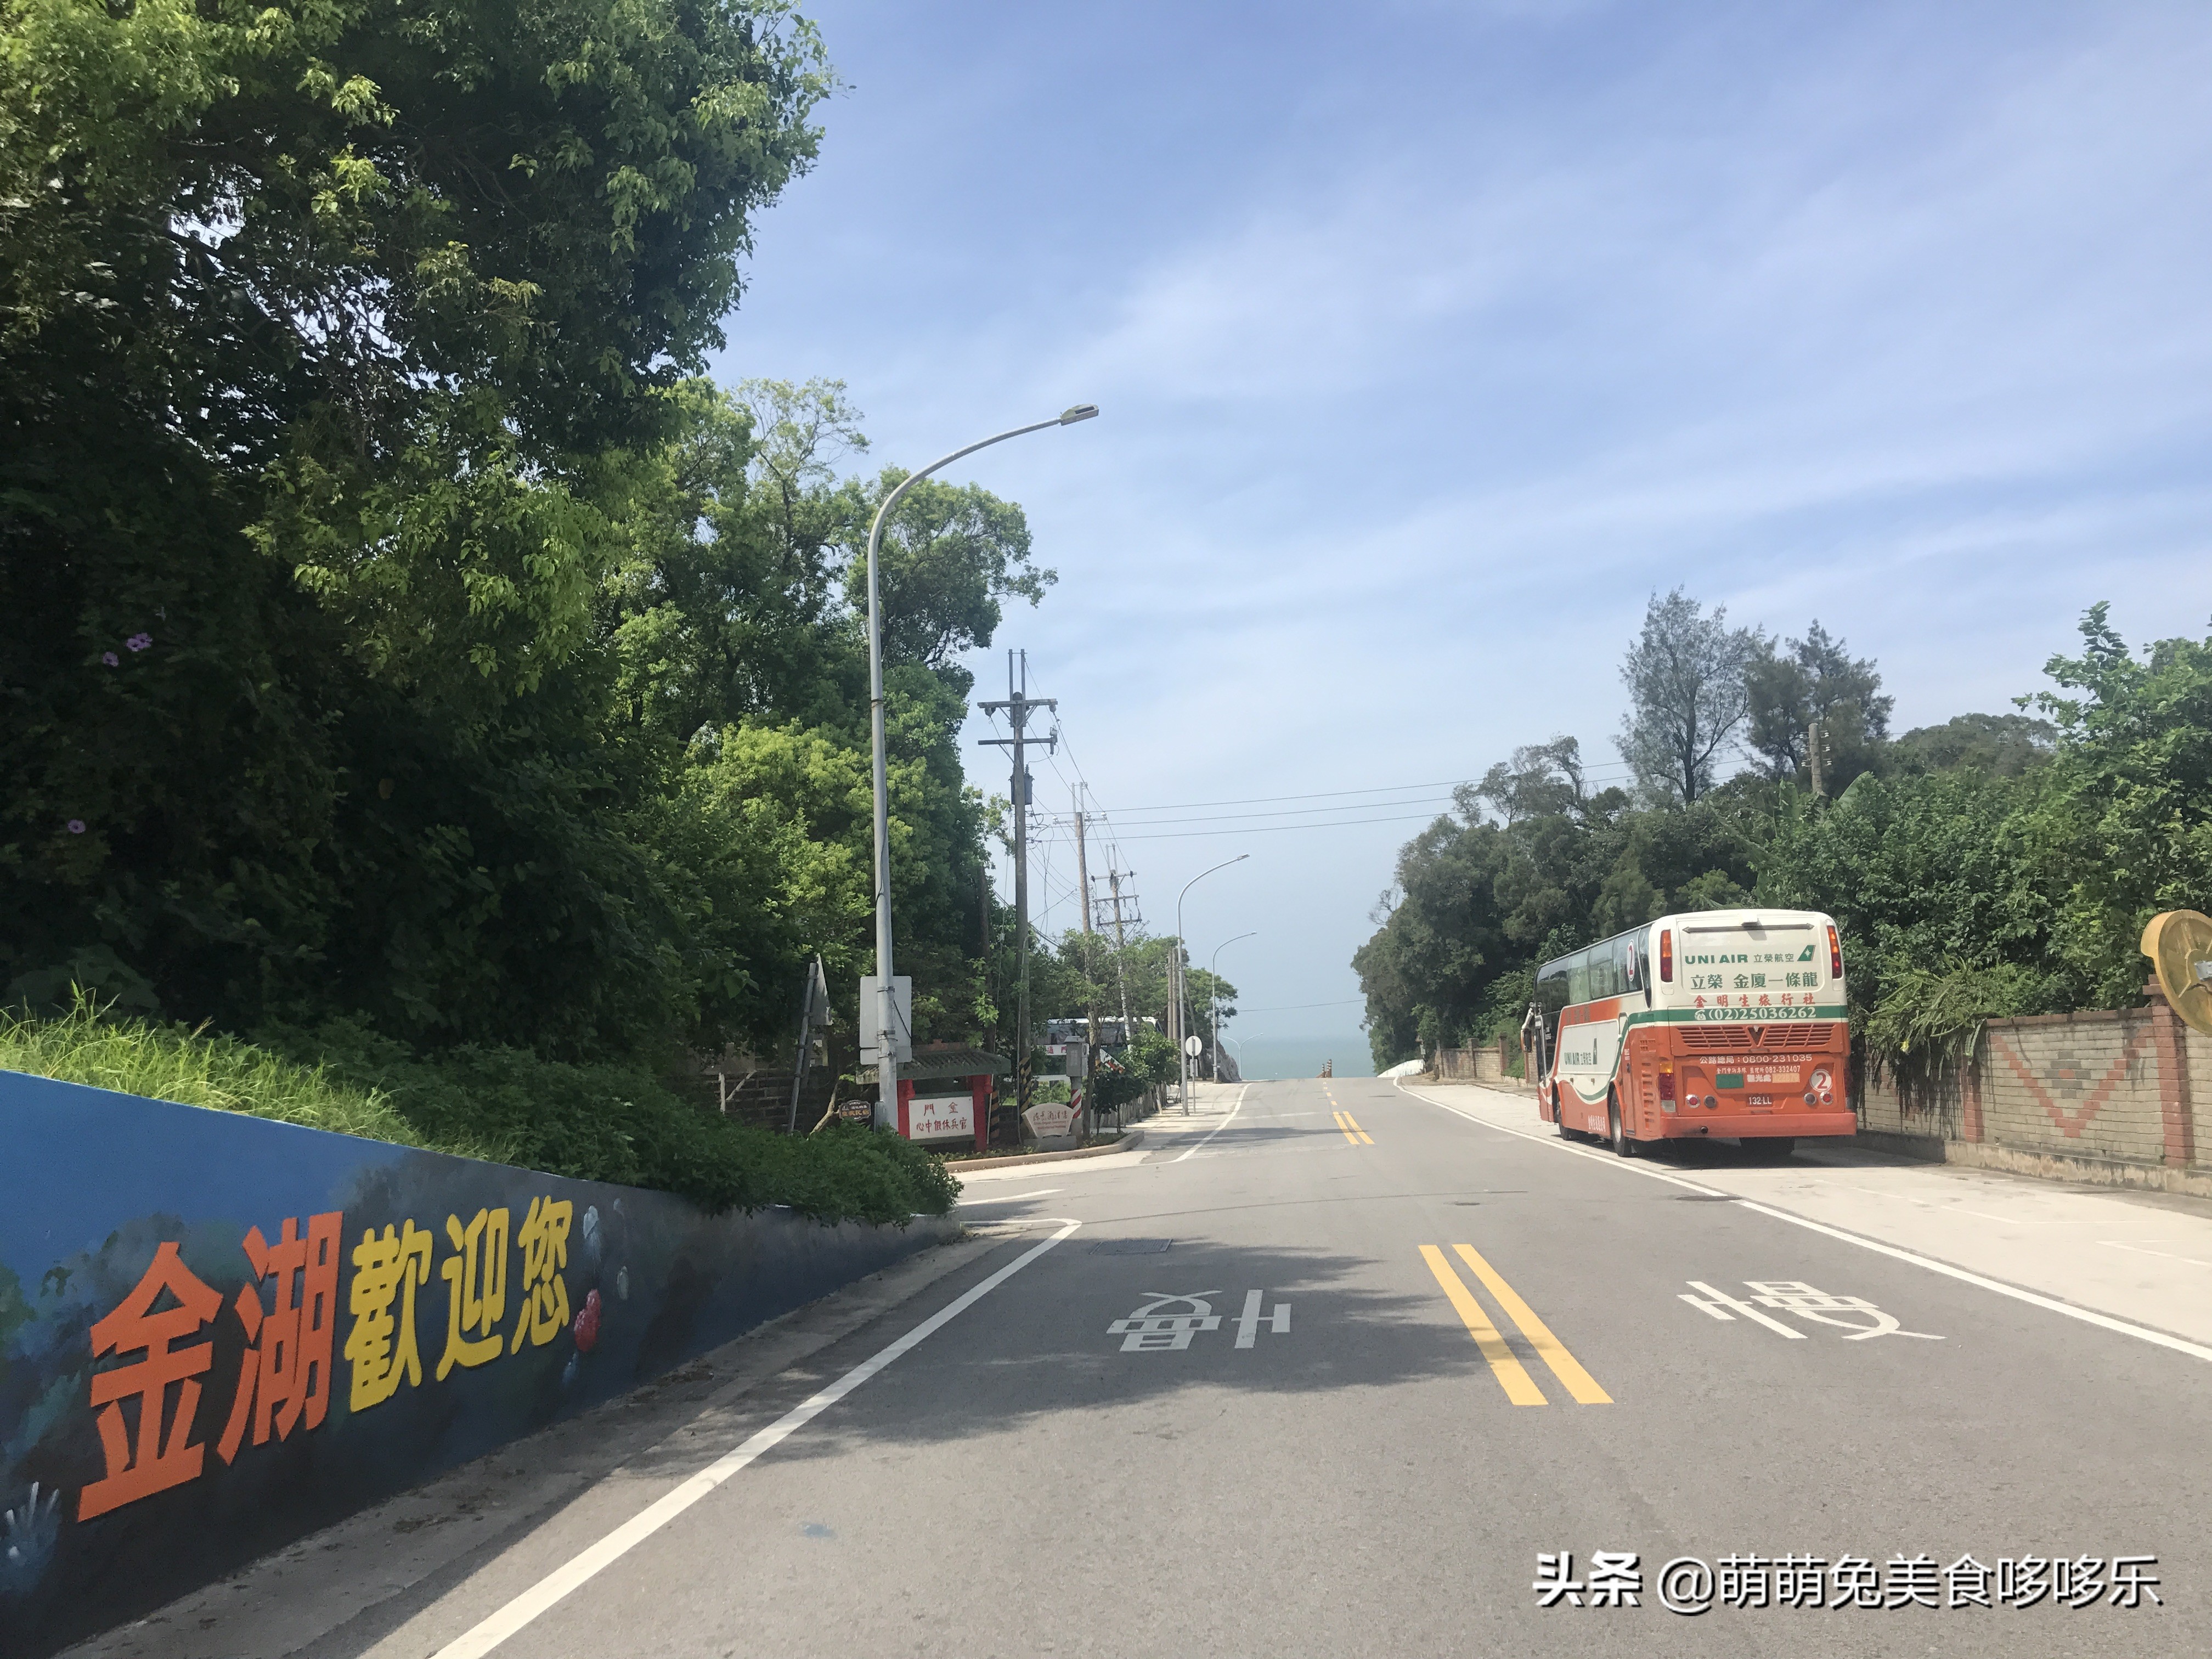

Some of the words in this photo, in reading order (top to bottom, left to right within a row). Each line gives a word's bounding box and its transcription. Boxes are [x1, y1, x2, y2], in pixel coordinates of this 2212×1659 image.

[1628, 945, 1633, 975] 2
[1685, 955, 1715, 964] UNI
[1719, 954, 1748, 964] AIR
[1753, 953, 1795, 963] 立榮航空
[1690, 974, 1723, 990] 立榮
[1734, 972, 1818, 989] 金廈一條龍
[1694, 992, 1816, 1008] 金明生旅行社
[1709, 1007, 1816, 1020] (02)25036262
[1564, 1052, 1572, 1065] UNI
[1816, 1072, 1828, 1090] 2
[1748, 1096, 1772, 1105] 132-LL
[1676, 1281, 1948, 1340] 慢
[76, 1196, 573, 1523] 金湖歡迎您
